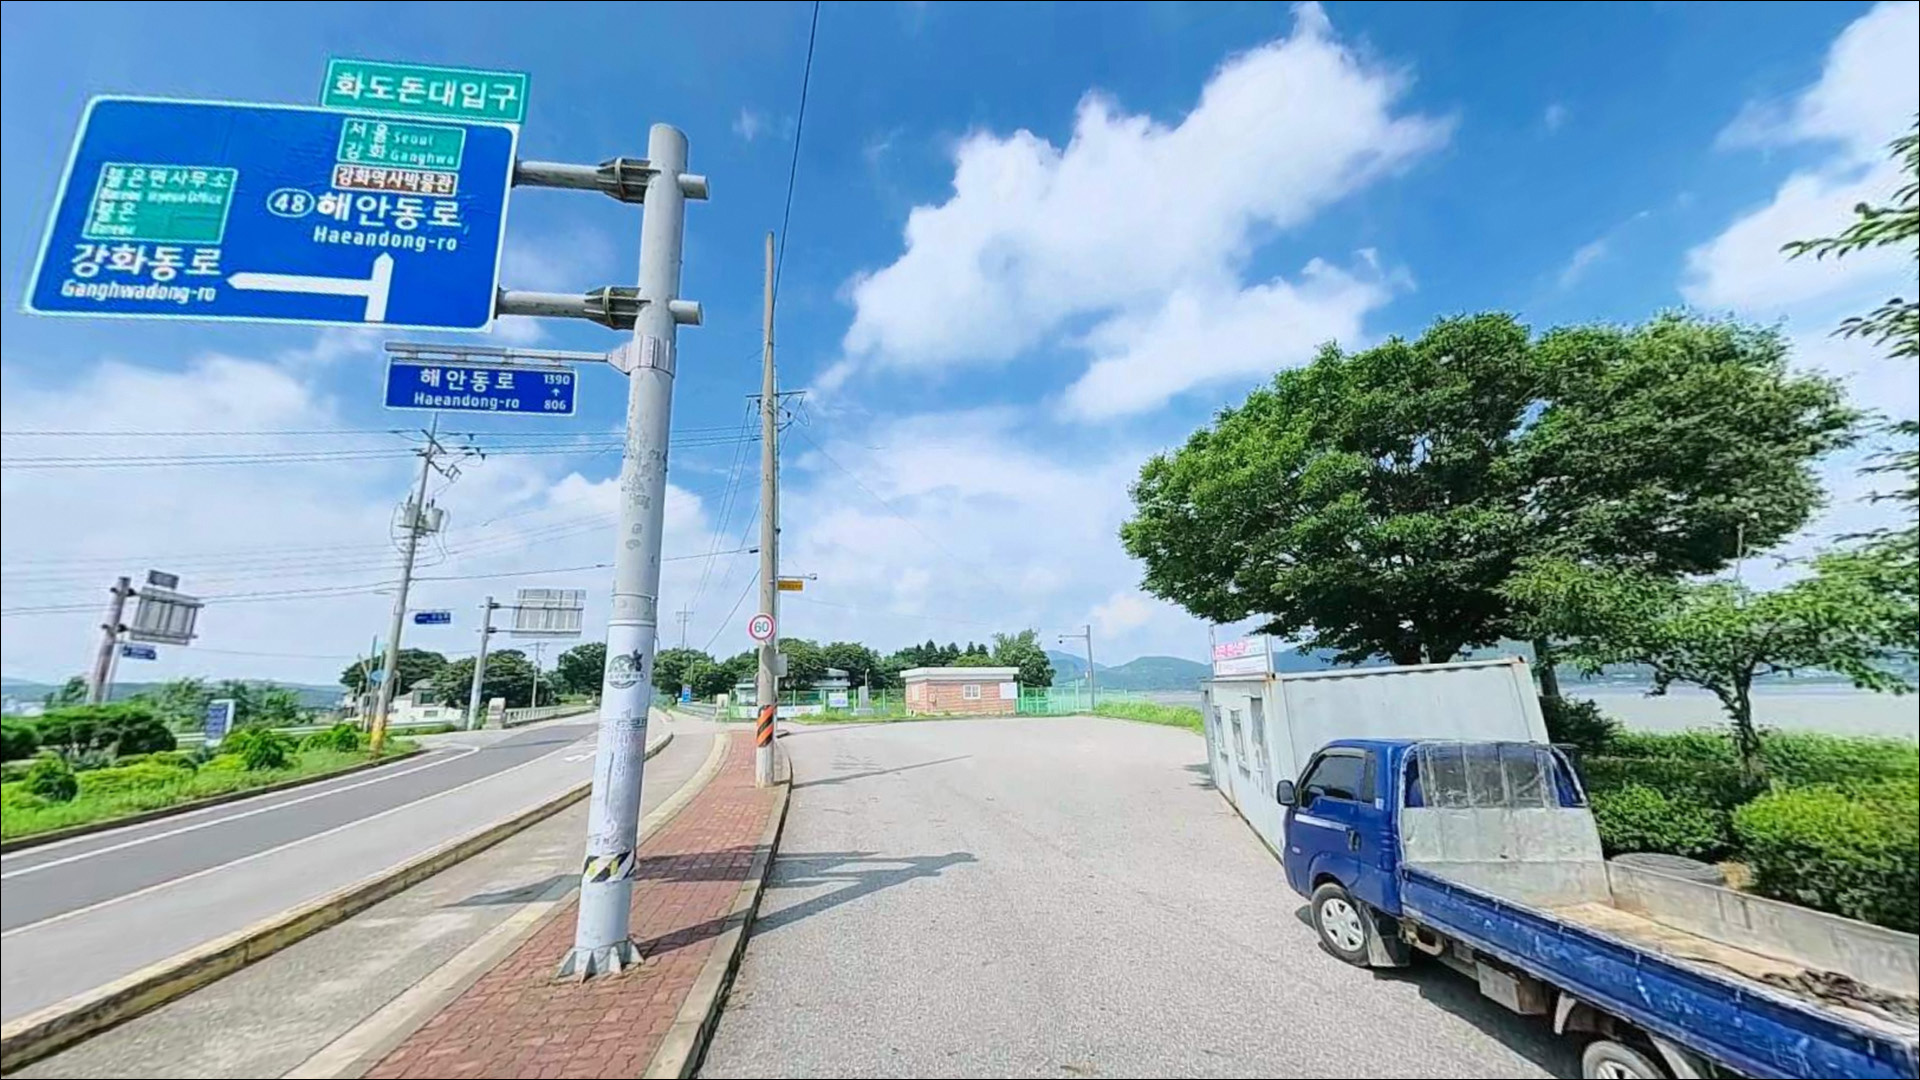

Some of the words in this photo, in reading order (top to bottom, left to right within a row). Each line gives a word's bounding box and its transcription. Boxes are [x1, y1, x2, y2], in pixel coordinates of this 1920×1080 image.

[332, 71, 518, 111] 화도돈대입구
[351, 121, 389, 144] 서울
[394, 131, 434, 146] Seoul
[346, 141, 387, 161] 강화
[390, 151, 455, 166] Ganghwa
[337, 166, 452, 193] 강화역사박물관
[273, 193, 307, 213] 48
[316, 191, 462, 231] 해안동로
[313, 225, 457, 252] Haeandong-ro
[71, 243, 222, 282] 강화동로
[61, 279, 217, 305] Ganghwadong-ro
[420, 368, 515, 393] 해안동로
[543, 374, 571, 386] 1390
[414, 391, 521, 411] Haeandong-ro
[543, 399, 567, 411] 806
[754, 621, 770, 633] 60
